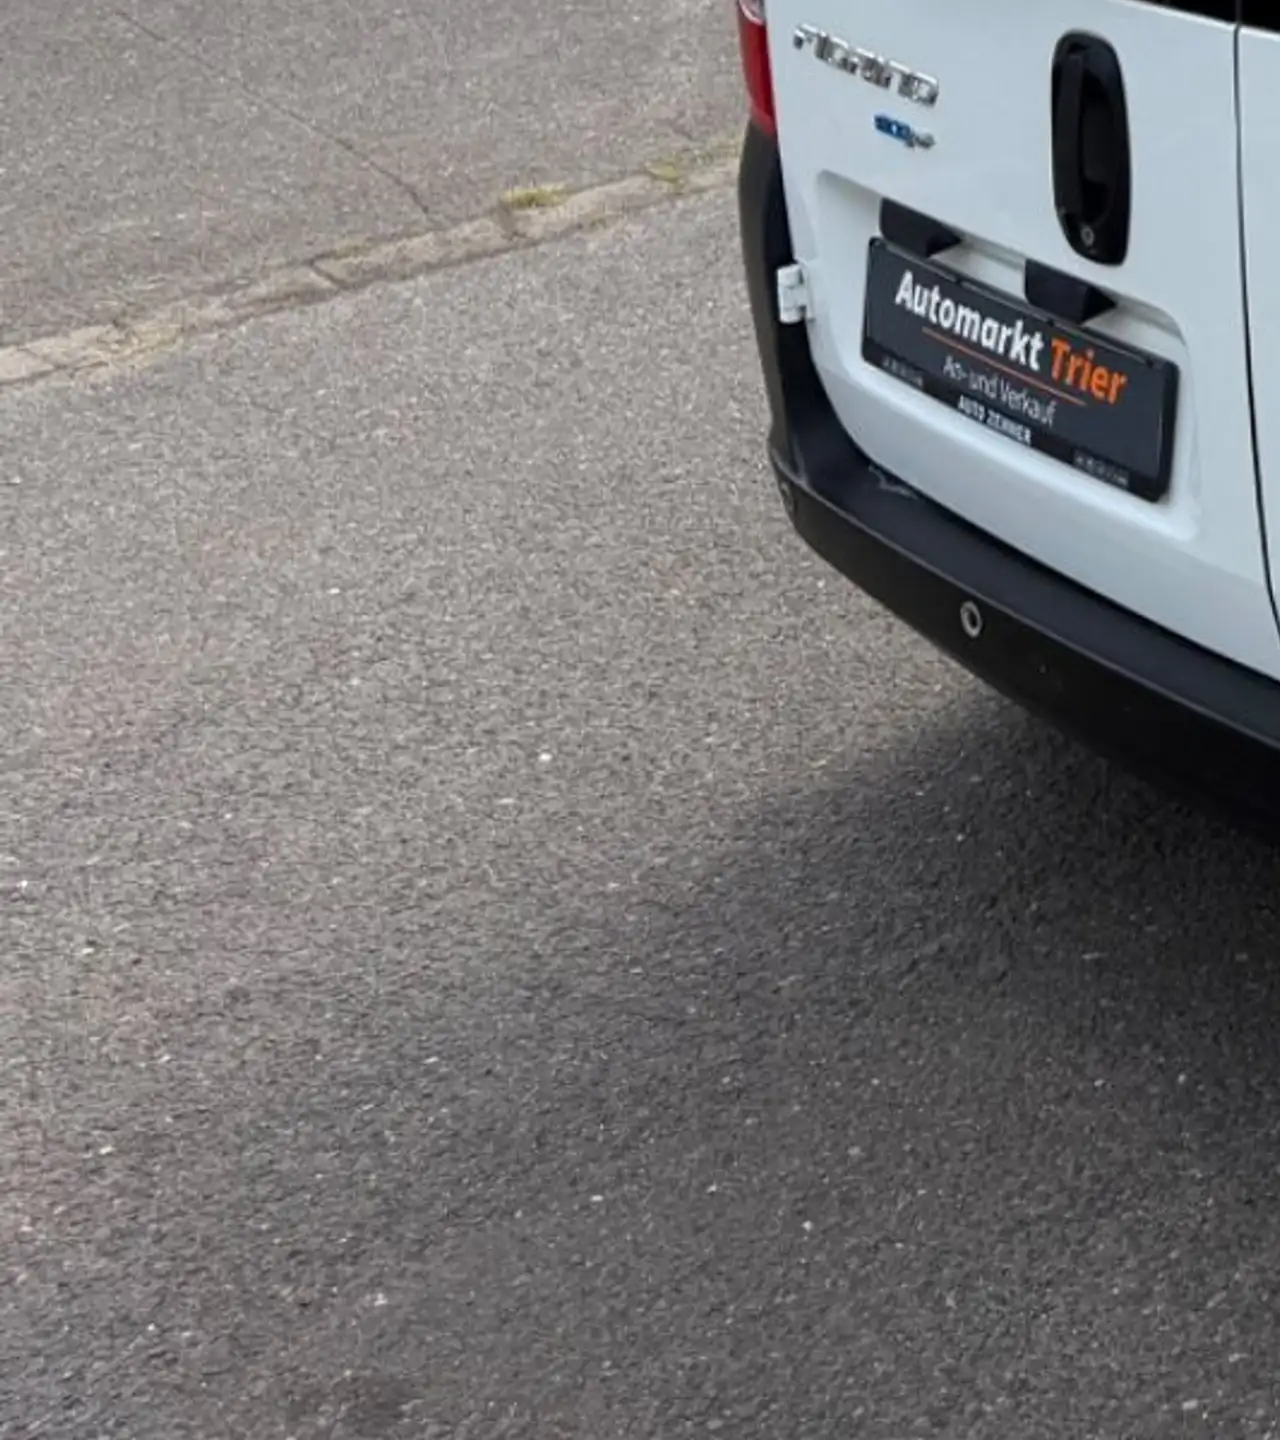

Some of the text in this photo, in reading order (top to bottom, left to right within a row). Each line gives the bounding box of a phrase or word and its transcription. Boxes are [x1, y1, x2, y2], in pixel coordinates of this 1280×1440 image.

[895, 269, 1128, 404] Automarkt Trier
[1000, 377, 1057, 428] Verkauf
